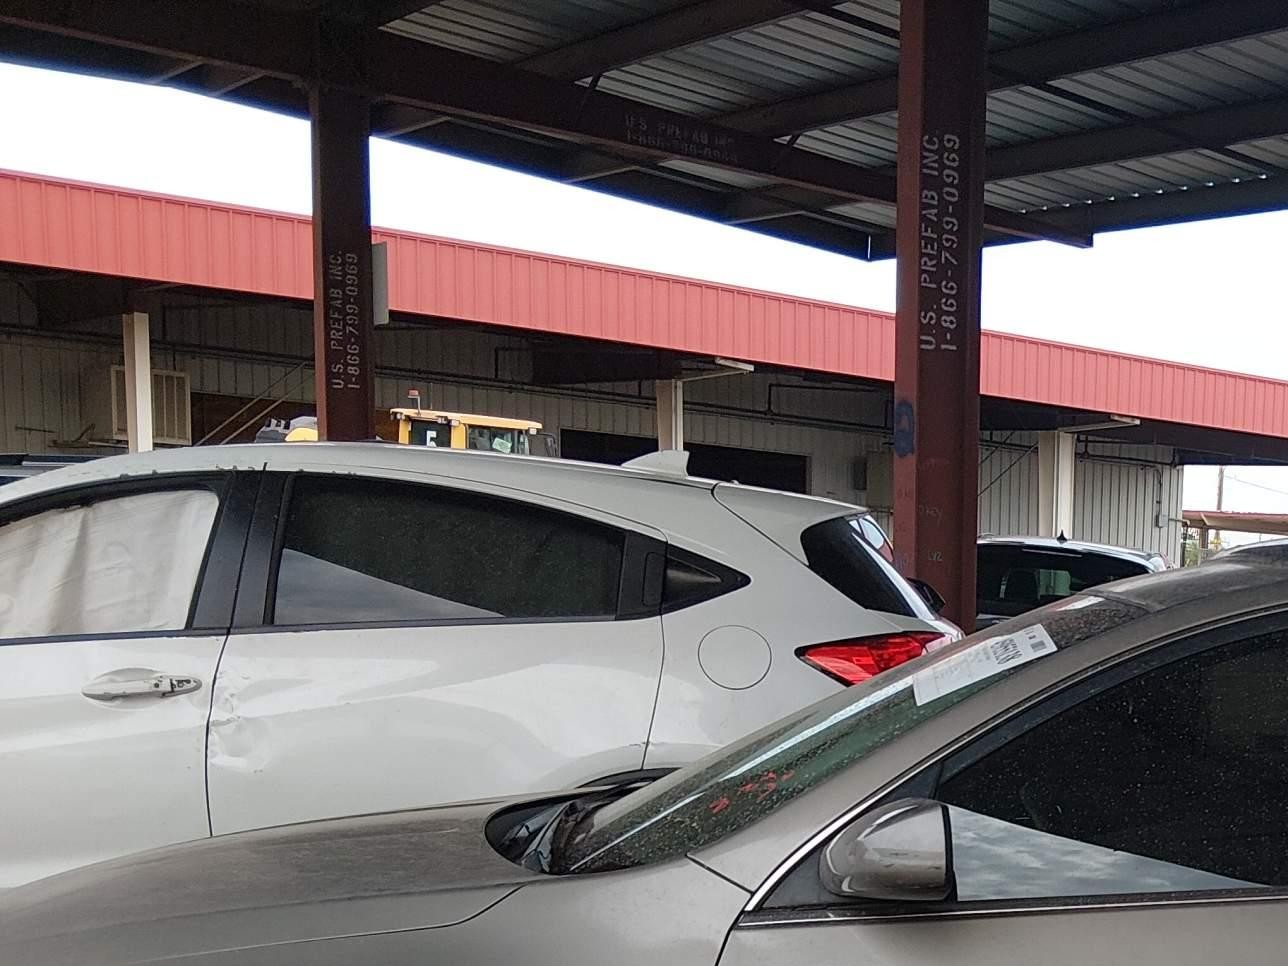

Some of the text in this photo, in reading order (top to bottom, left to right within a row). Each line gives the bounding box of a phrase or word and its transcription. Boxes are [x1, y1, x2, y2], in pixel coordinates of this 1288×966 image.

[921, 190, 938, 289] PREFAB
[940, 133, 960, 351] 1-866-799-0969
[328, 250, 345, 389] U.S. PREFAB INC.
[346, 253, 360, 389] 1-866-799-0969
[920, 304, 937, 350] U.S.
